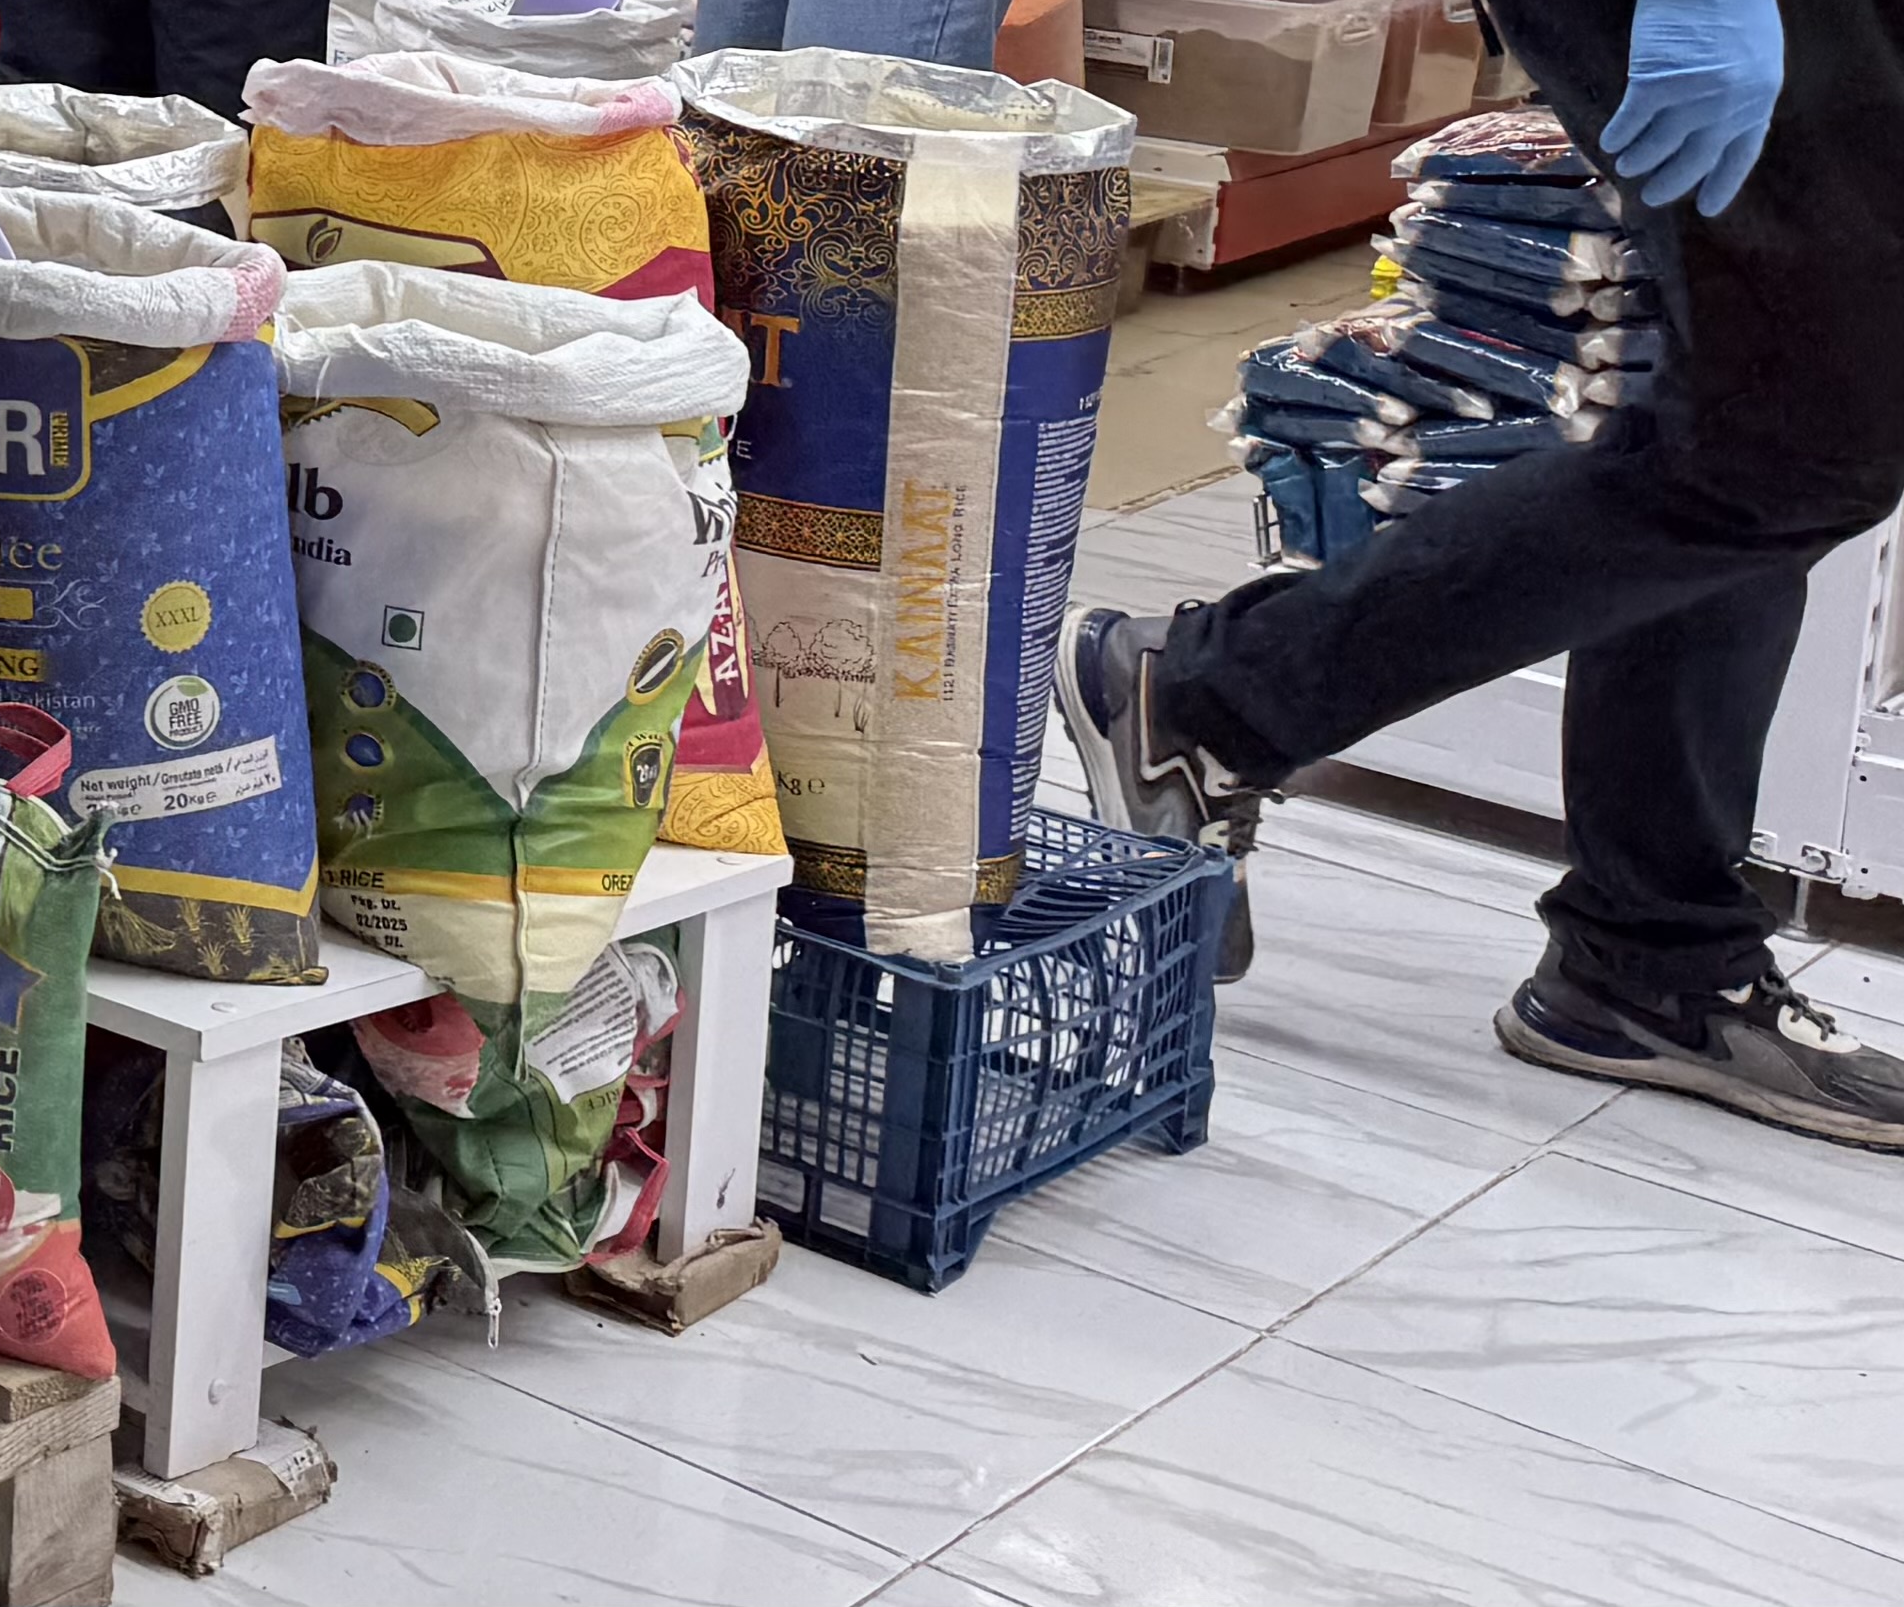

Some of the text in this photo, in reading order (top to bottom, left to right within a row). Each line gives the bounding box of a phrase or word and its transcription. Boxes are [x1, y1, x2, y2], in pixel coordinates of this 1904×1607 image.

[953, 485, 968, 518] RICE
[293, 536, 352, 566] ndia
[155, 606, 202, 628] XXXL
[169, 697, 200, 716] GMO
[169, 712, 202, 729] FREE
[341, 869, 385, 889] RICE
